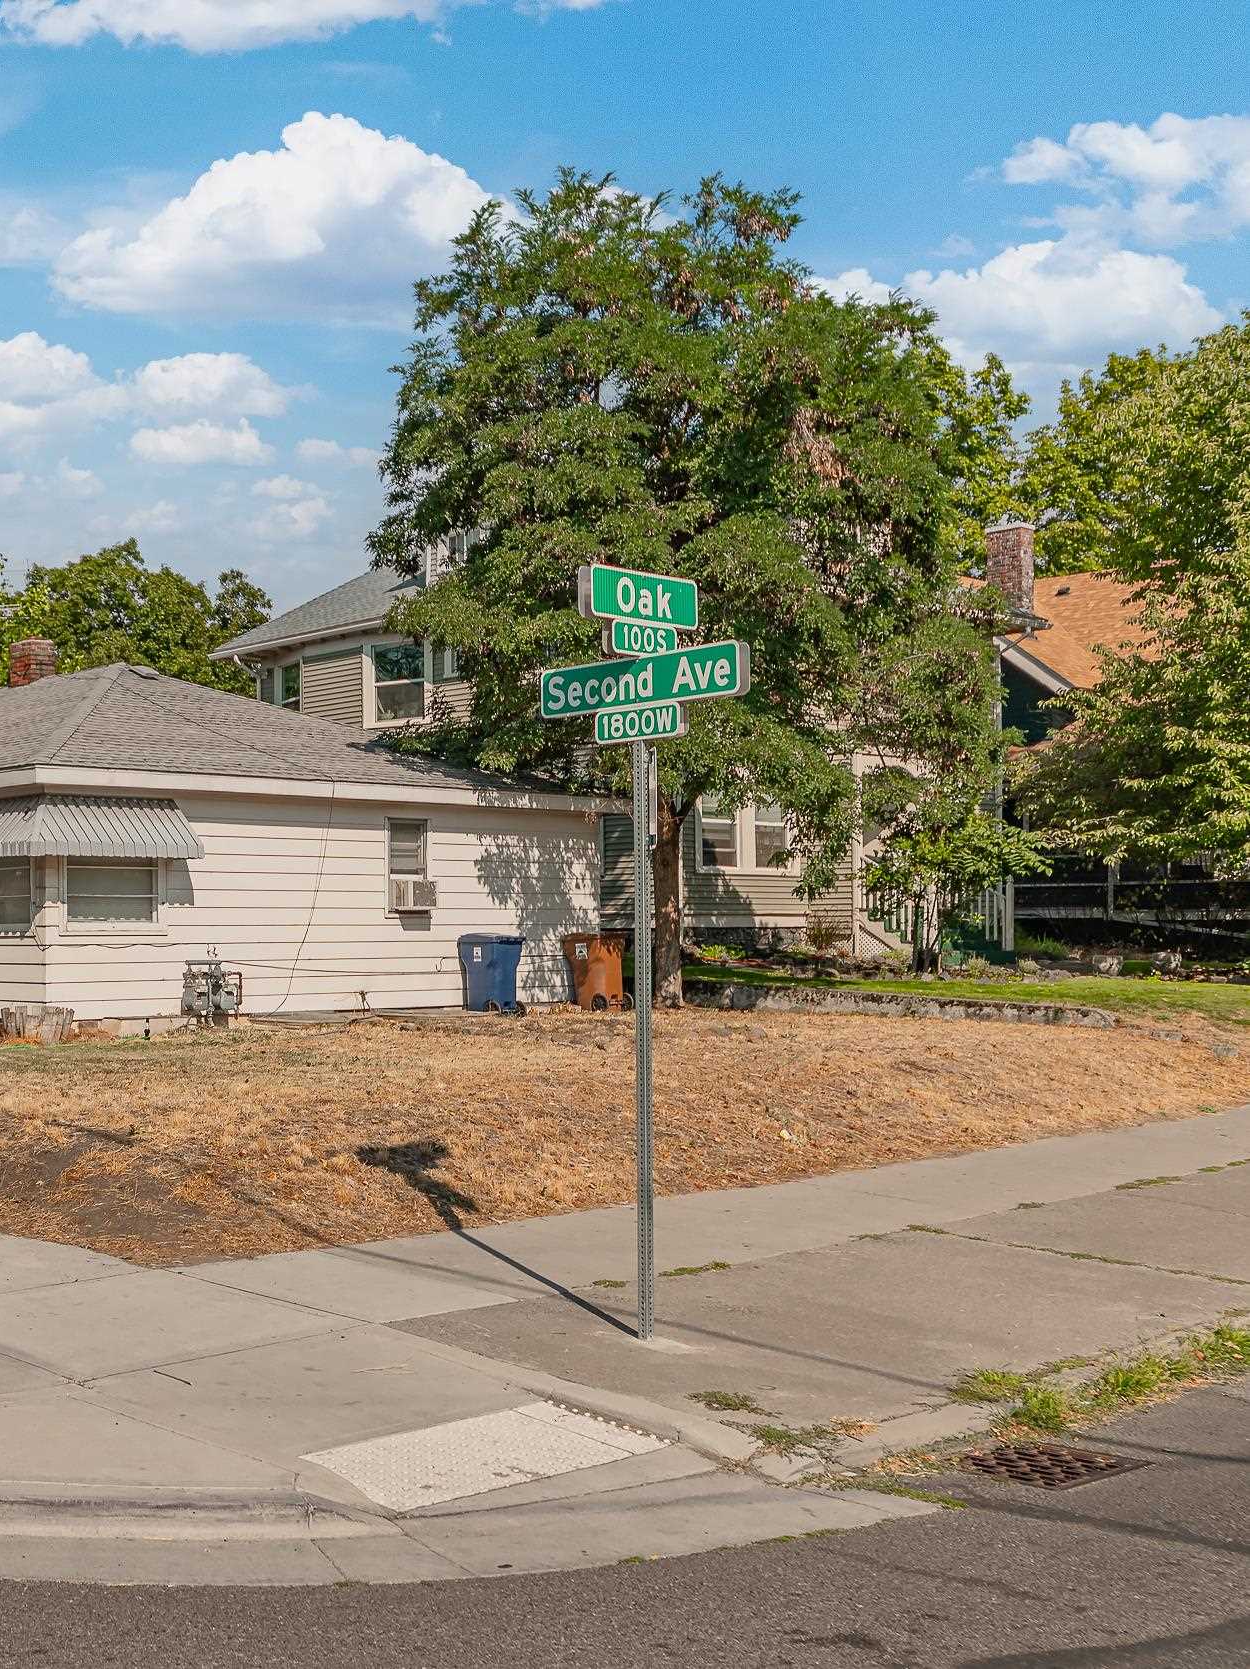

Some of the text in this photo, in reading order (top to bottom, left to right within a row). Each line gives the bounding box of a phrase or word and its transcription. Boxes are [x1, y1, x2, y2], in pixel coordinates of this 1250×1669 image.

[616, 576, 672, 619] Oak
[623, 625, 667, 653] 100S
[547, 655, 731, 710] Second Ave
[602, 709, 673, 738] 1800W
